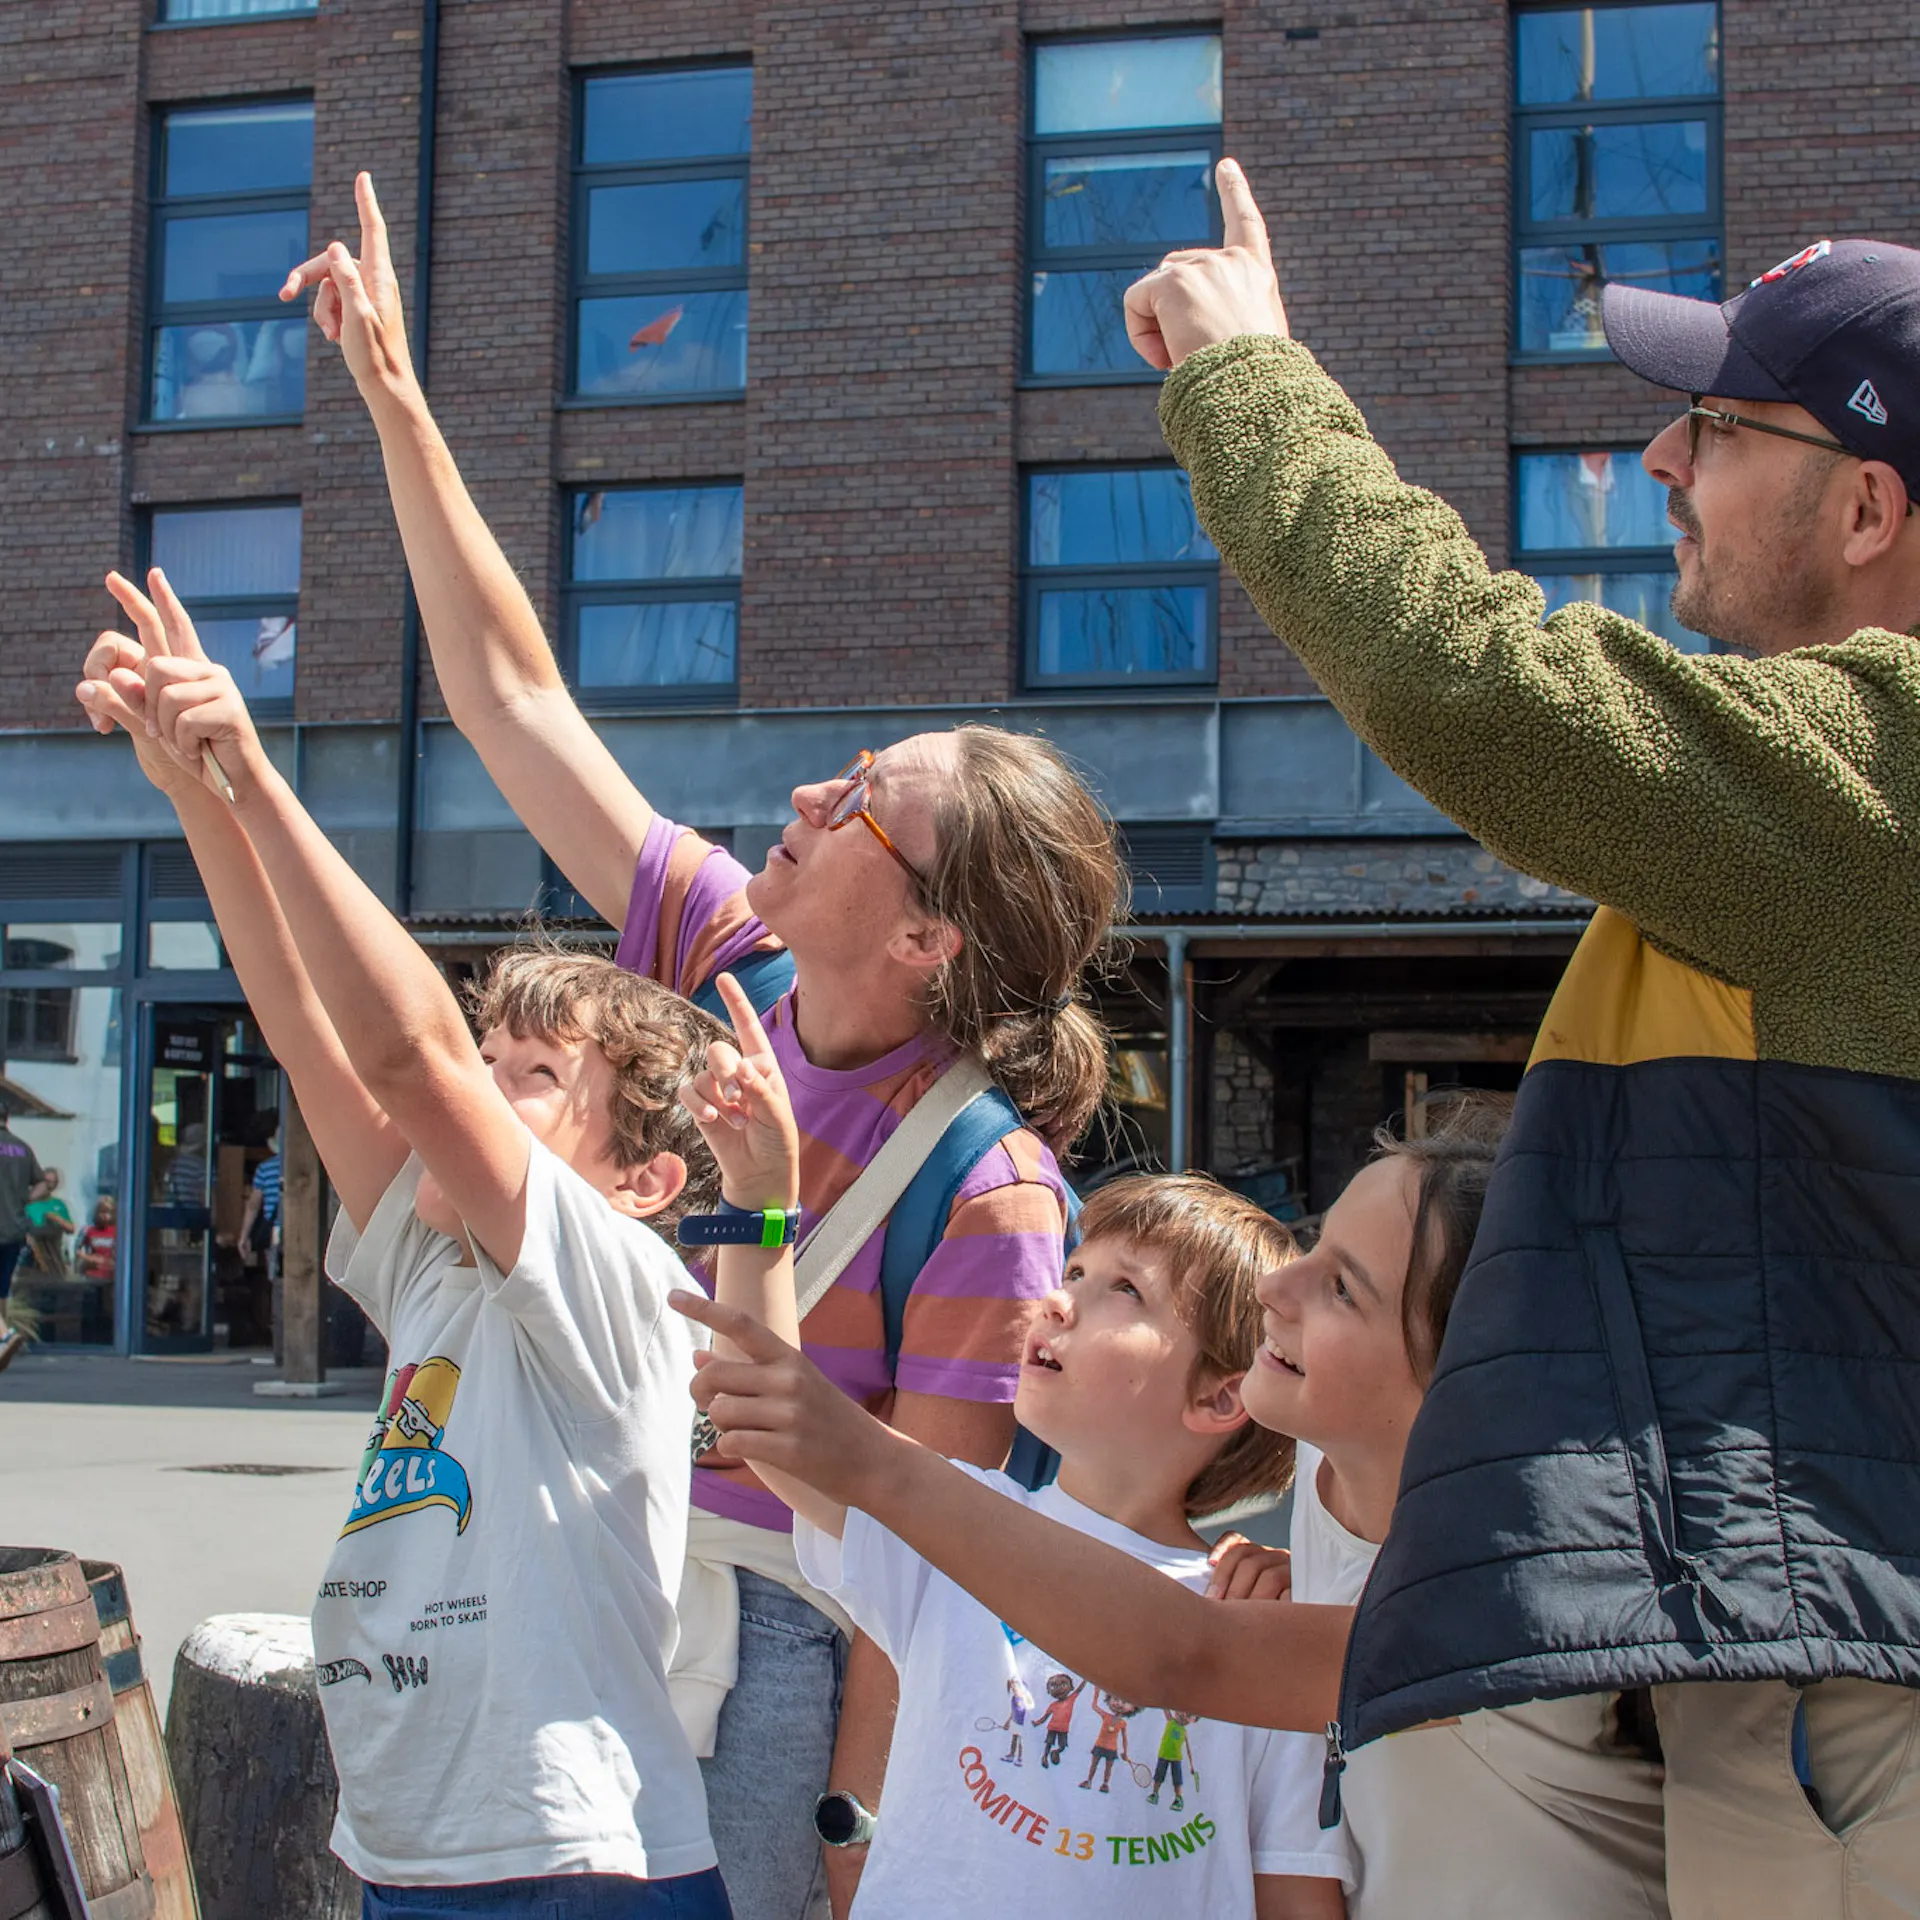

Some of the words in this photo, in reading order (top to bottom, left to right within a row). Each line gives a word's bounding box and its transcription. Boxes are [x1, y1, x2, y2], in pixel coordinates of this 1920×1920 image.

[348, 1580, 387, 1598] SHOP
[424, 1601, 444, 1615] HOT
[446, 1594, 487, 1610] WHEELS
[410, 1619, 438, 1632] BORN
[440, 1615, 454, 1627] TO
[959, 1746, 1049, 1846] COMITE
[1053, 1828, 1095, 1861] 13
[1105, 1812, 1216, 1865] TENNIS
